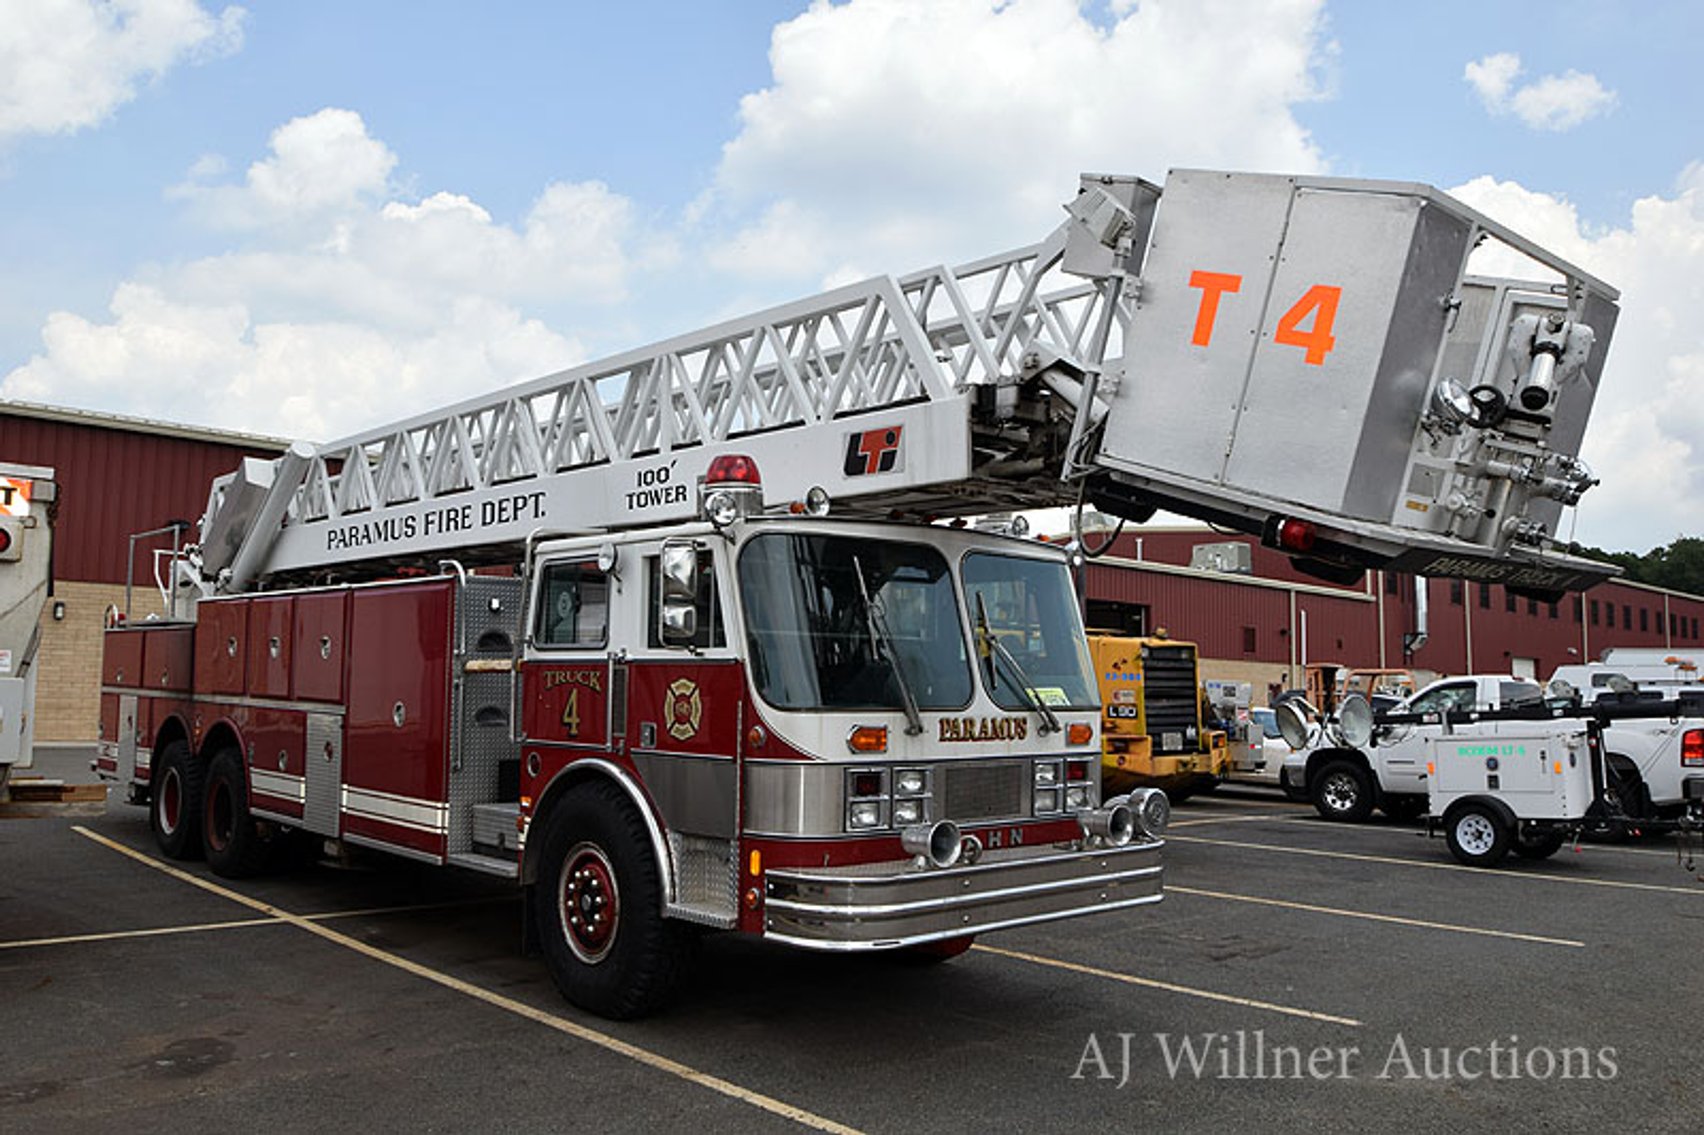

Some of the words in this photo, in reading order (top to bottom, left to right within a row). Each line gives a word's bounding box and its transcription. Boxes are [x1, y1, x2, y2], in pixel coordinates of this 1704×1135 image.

[1188, 270, 1243, 347] T
[1273, 284, 1343, 366] 4
[626, 485, 688, 510] TOWER
[327, 515, 416, 551] PARAMUS
[424, 505, 473, 535] FIRE
[481, 493, 546, 527] DEPT.
[544, 670, 602, 692] TRUCK
[562, 688, 580, 737] 4
[938, 716, 1028, 742] PARAMUS
